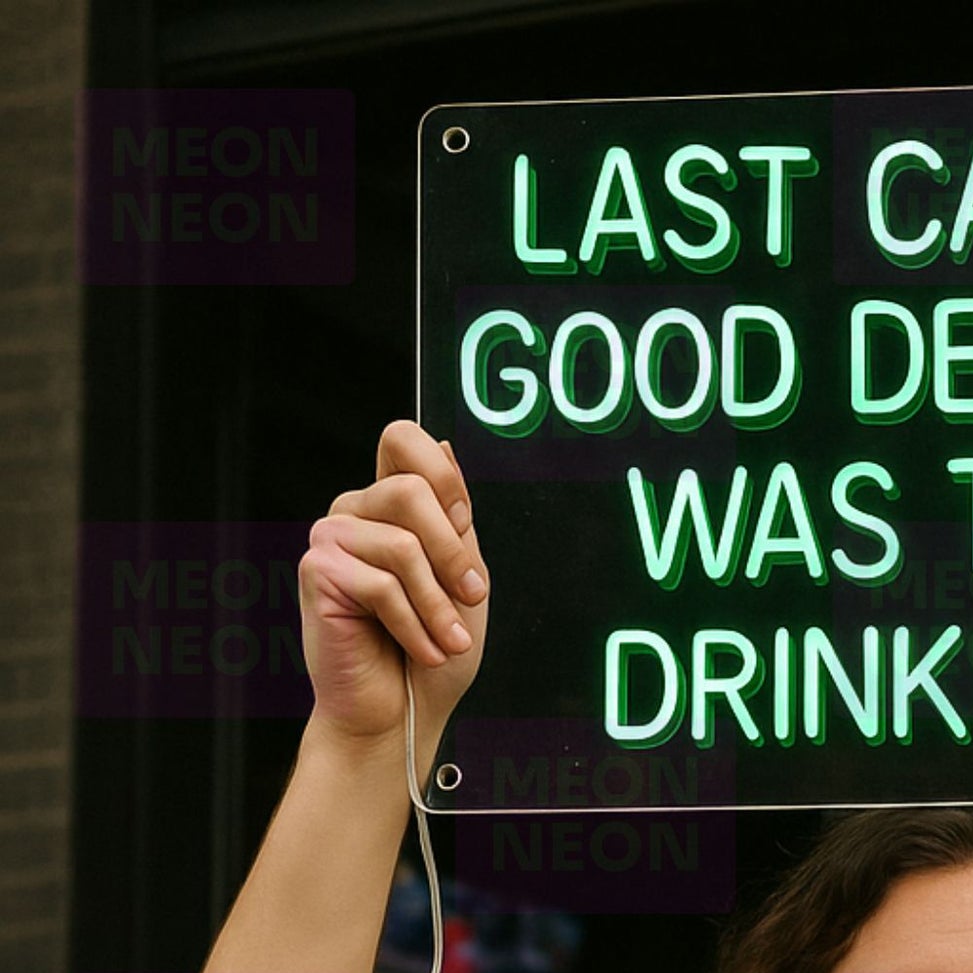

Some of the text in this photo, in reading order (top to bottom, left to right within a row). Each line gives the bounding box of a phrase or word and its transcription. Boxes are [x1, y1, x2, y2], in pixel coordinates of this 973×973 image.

[513, 143, 815, 268] LAST
[460, 304, 798, 430] GOOD
[626, 461, 902, 583] WAS
